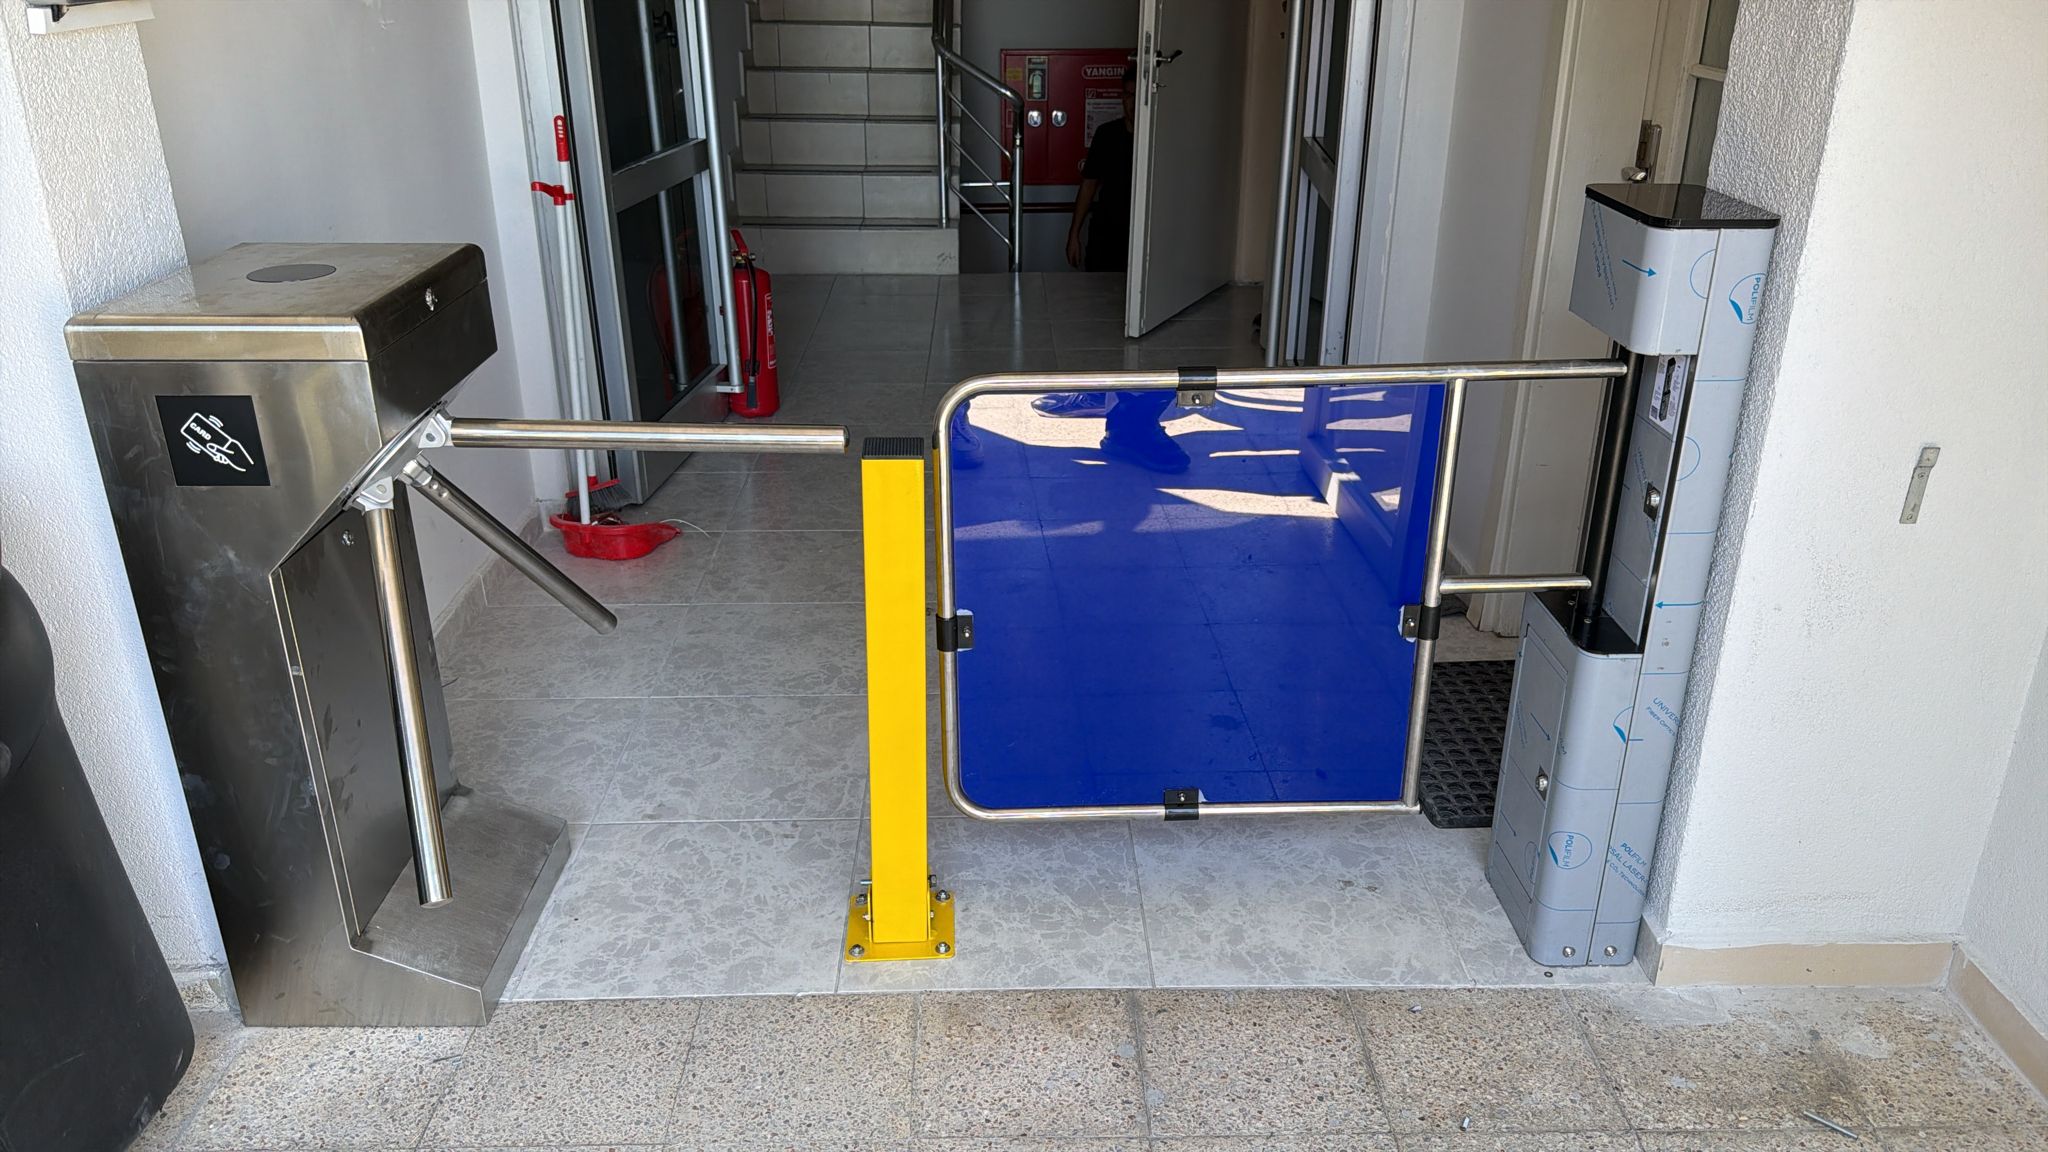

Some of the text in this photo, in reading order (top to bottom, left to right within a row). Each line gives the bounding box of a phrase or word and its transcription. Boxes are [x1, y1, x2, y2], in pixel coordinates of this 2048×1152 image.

[1086, 67, 1125, 77] YANGIN
[1747, 276, 1761, 321] POLIFILM
[190, 422, 212, 441] CARD
[1563, 834, 1575, 867] POLIFILM
